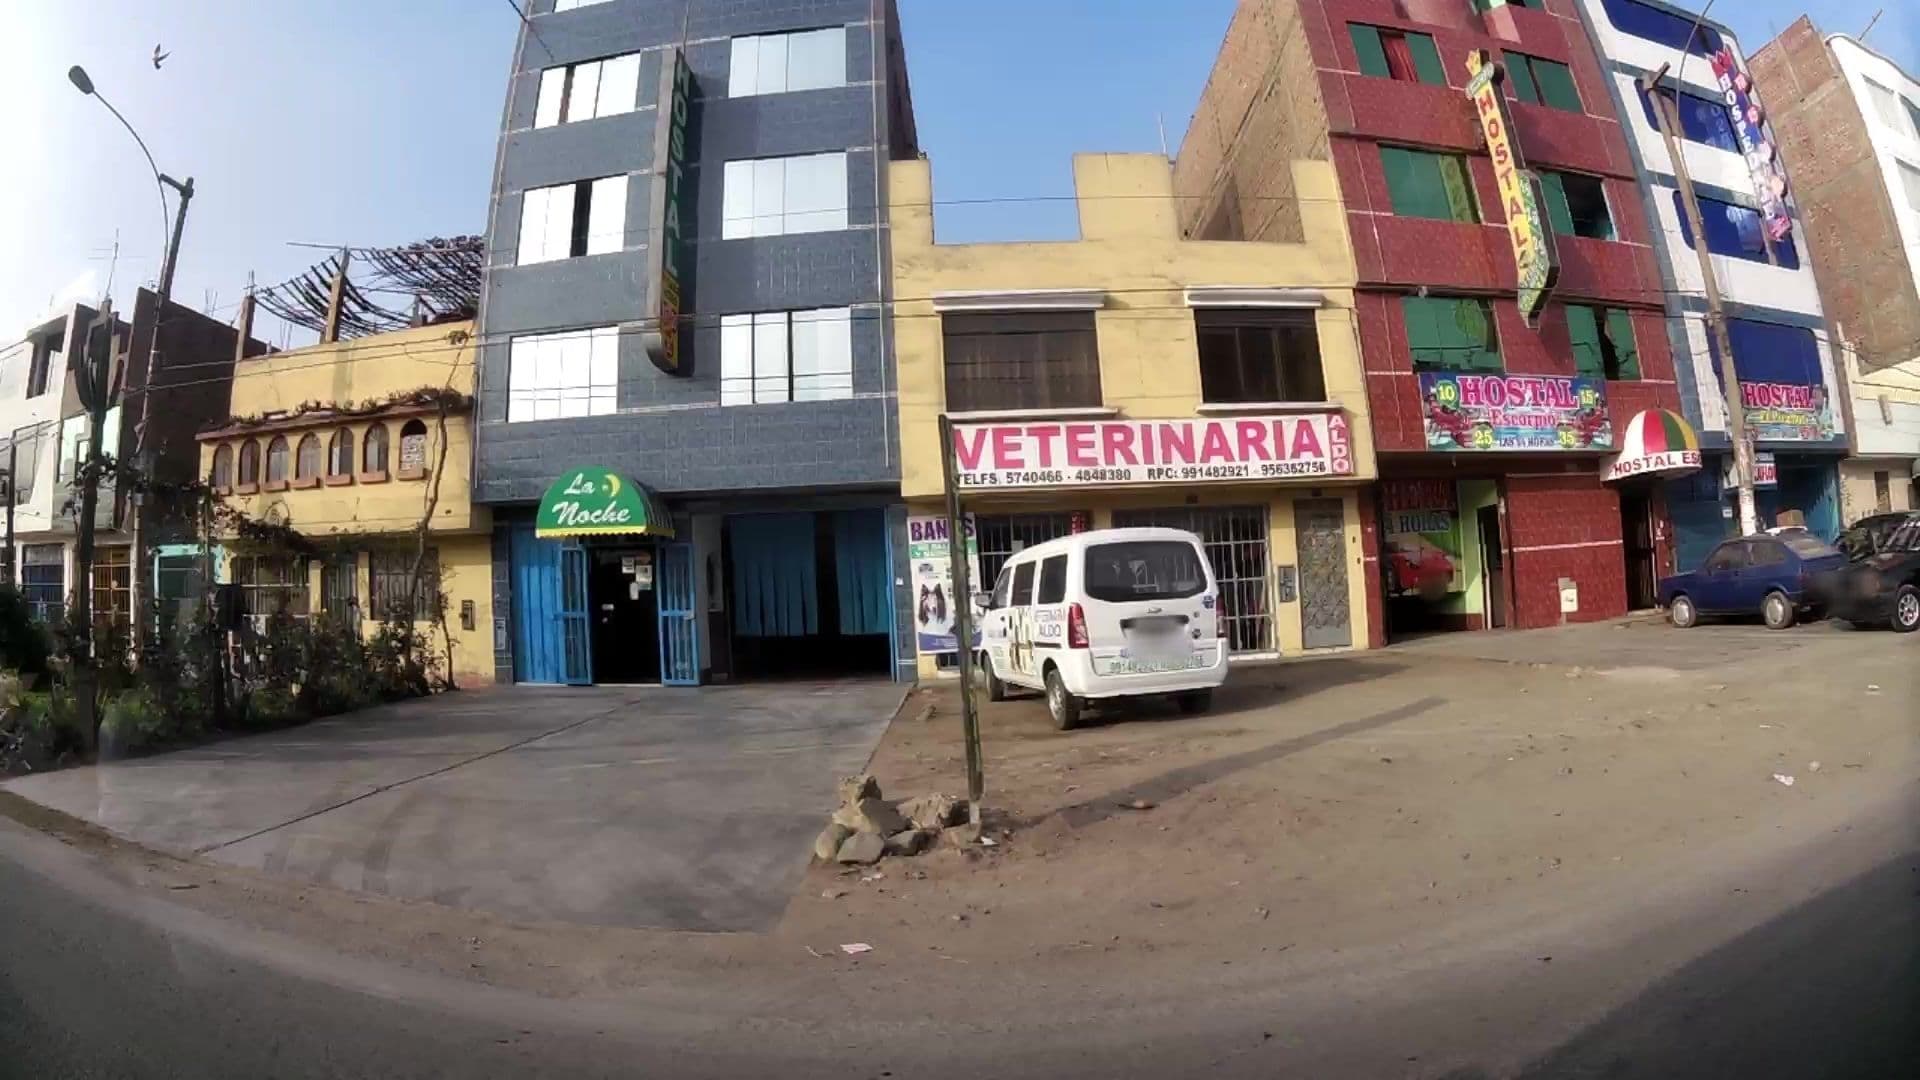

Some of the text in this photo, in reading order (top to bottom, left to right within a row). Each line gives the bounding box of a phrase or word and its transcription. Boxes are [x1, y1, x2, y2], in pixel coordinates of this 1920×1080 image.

[665, 61, 690, 277] HOSTAL
[1479, 93, 1529, 247] HOSTAL
[1438, 385, 1455, 401] 10
[1456, 375, 1579, 409] HOSTAL
[1742, 383, 1814, 409] HOSTAL
[955, 419, 1325, 470] VETERINARIA
[1329, 415, 1349, 473] ALDO
[1475, 430, 1493, 445] 25
[1613, 453, 1676, 476] HOSTAL
[563, 473, 596, 495] La
[551, 500, 632, 526] Noche
